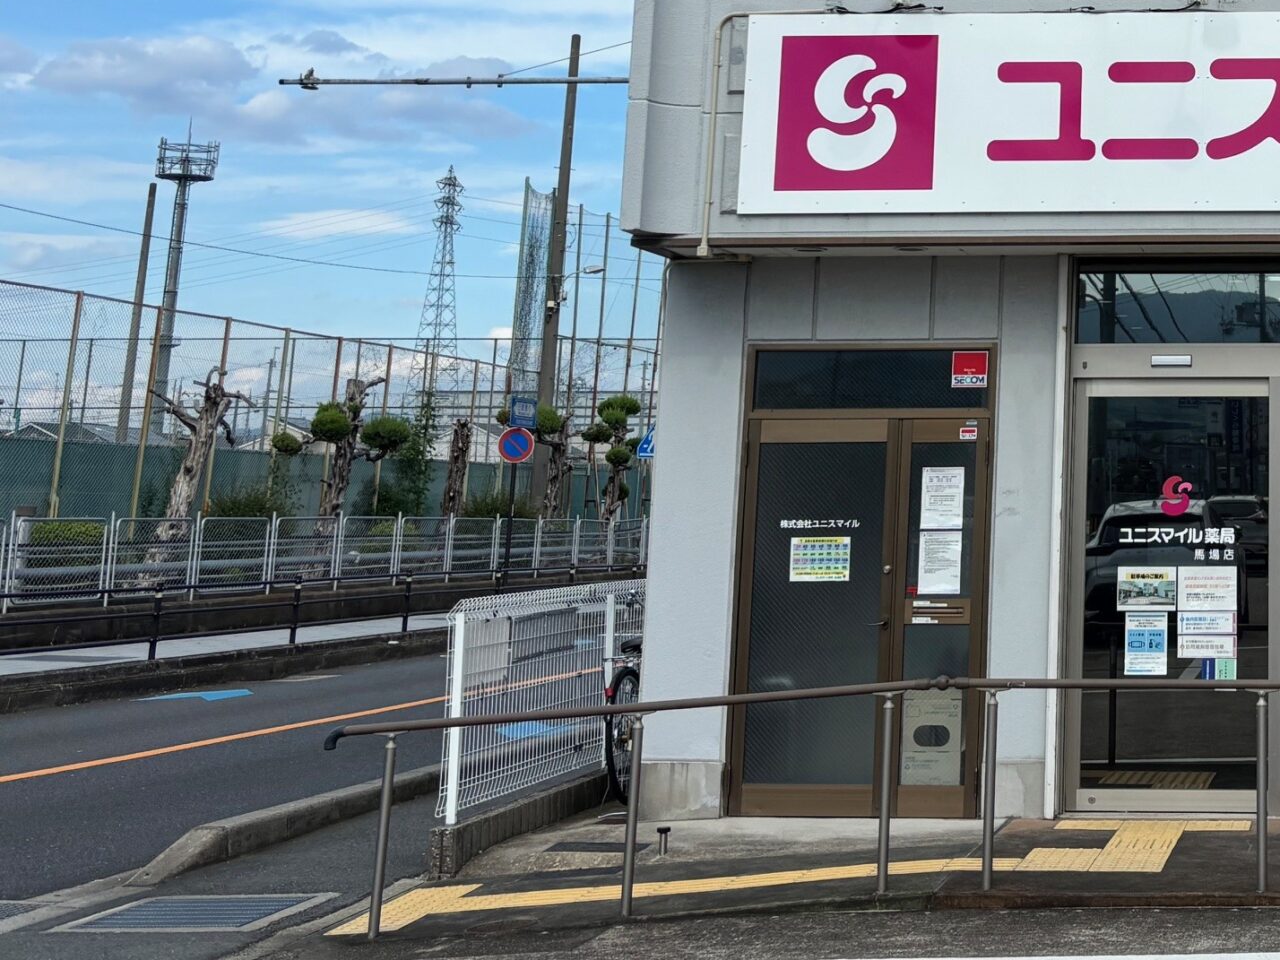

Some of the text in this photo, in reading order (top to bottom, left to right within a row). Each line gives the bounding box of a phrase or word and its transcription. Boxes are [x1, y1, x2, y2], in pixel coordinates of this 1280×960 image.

[954, 376, 985, 384] SECOM
[780, 519, 860, 529] 株式会社ユニスマイル
[1118, 527, 1235, 544] ユニスマイル薬局
